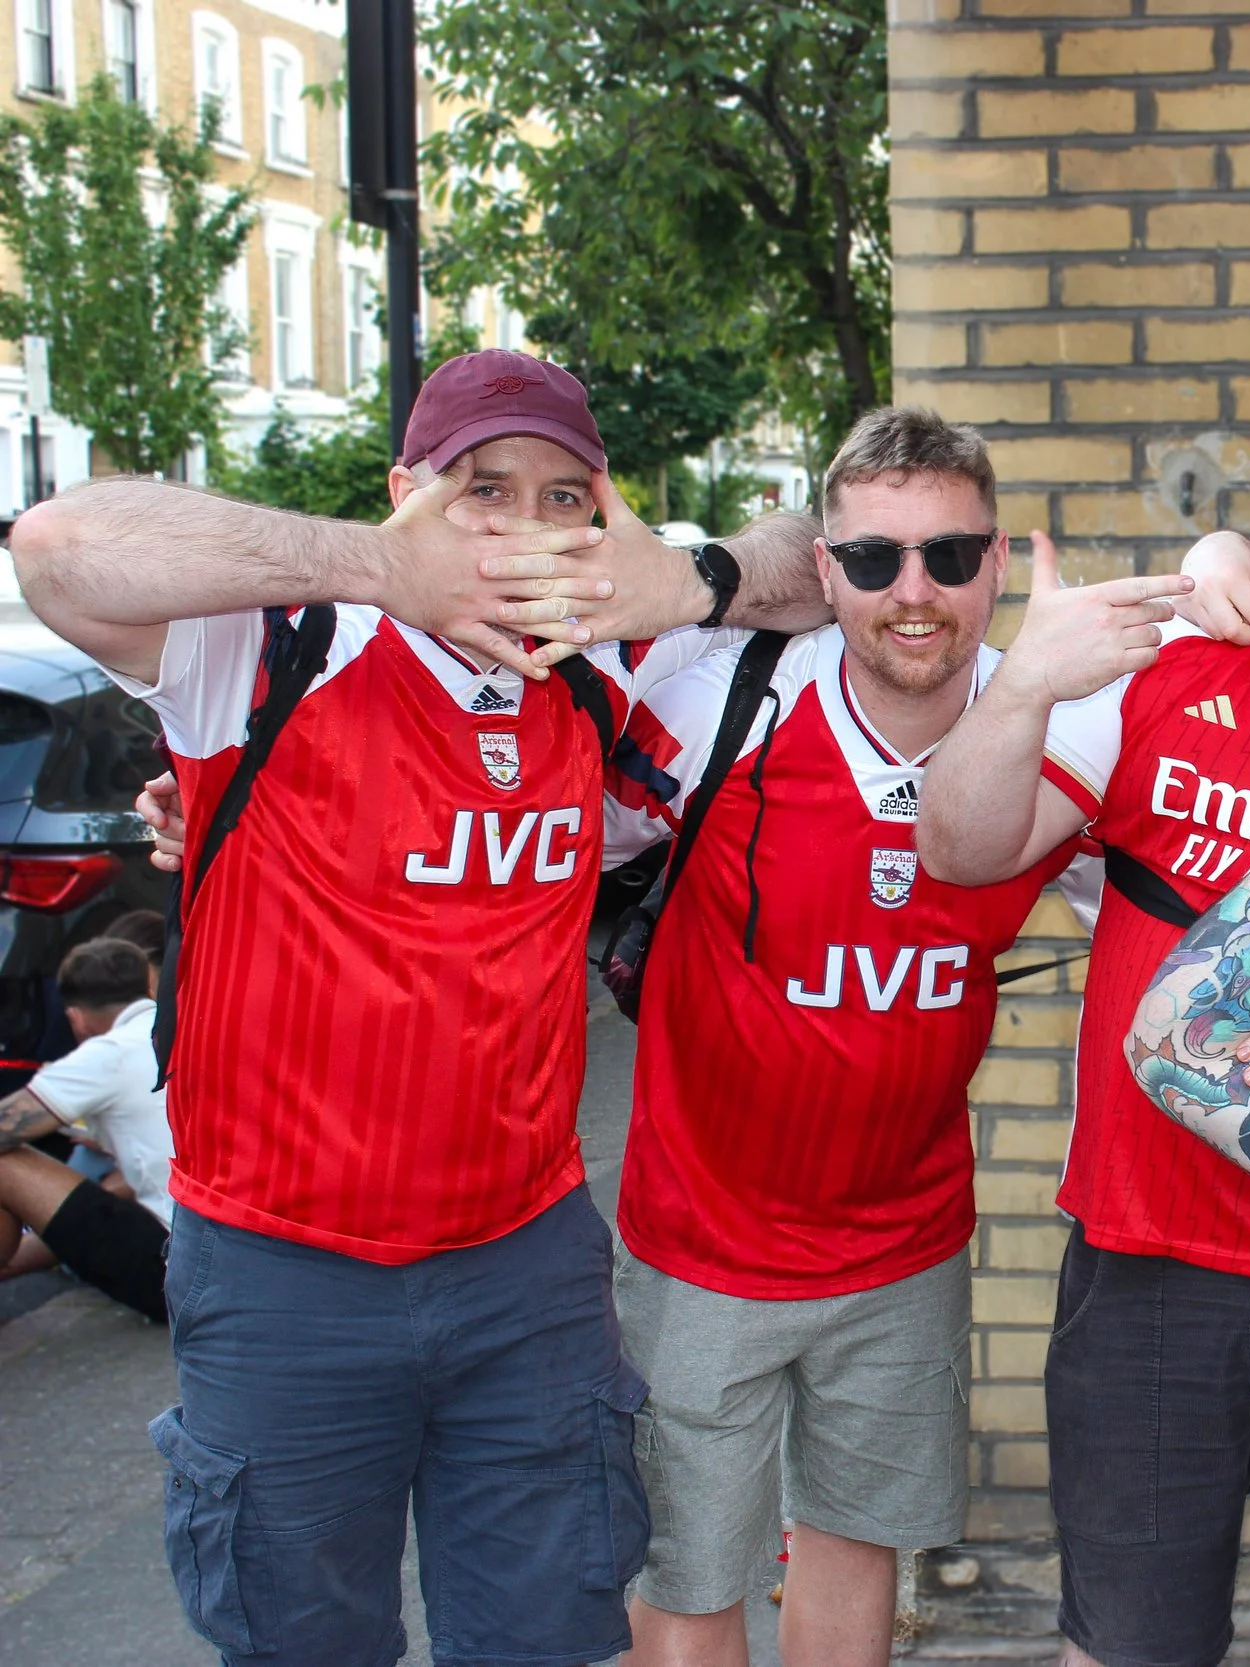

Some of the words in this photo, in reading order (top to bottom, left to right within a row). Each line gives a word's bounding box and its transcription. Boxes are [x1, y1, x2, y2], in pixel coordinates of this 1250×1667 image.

[480, 735, 515, 745] Arsenal
[880, 798, 918, 811] adida
[879, 808, 919, 817] EQUIPMEN
[404, 806, 582, 886] JVC
[874, 851, 916, 863] Arsenal
[1170, 833, 1244, 882] FLY
[786, 943, 970, 1013] JVC
